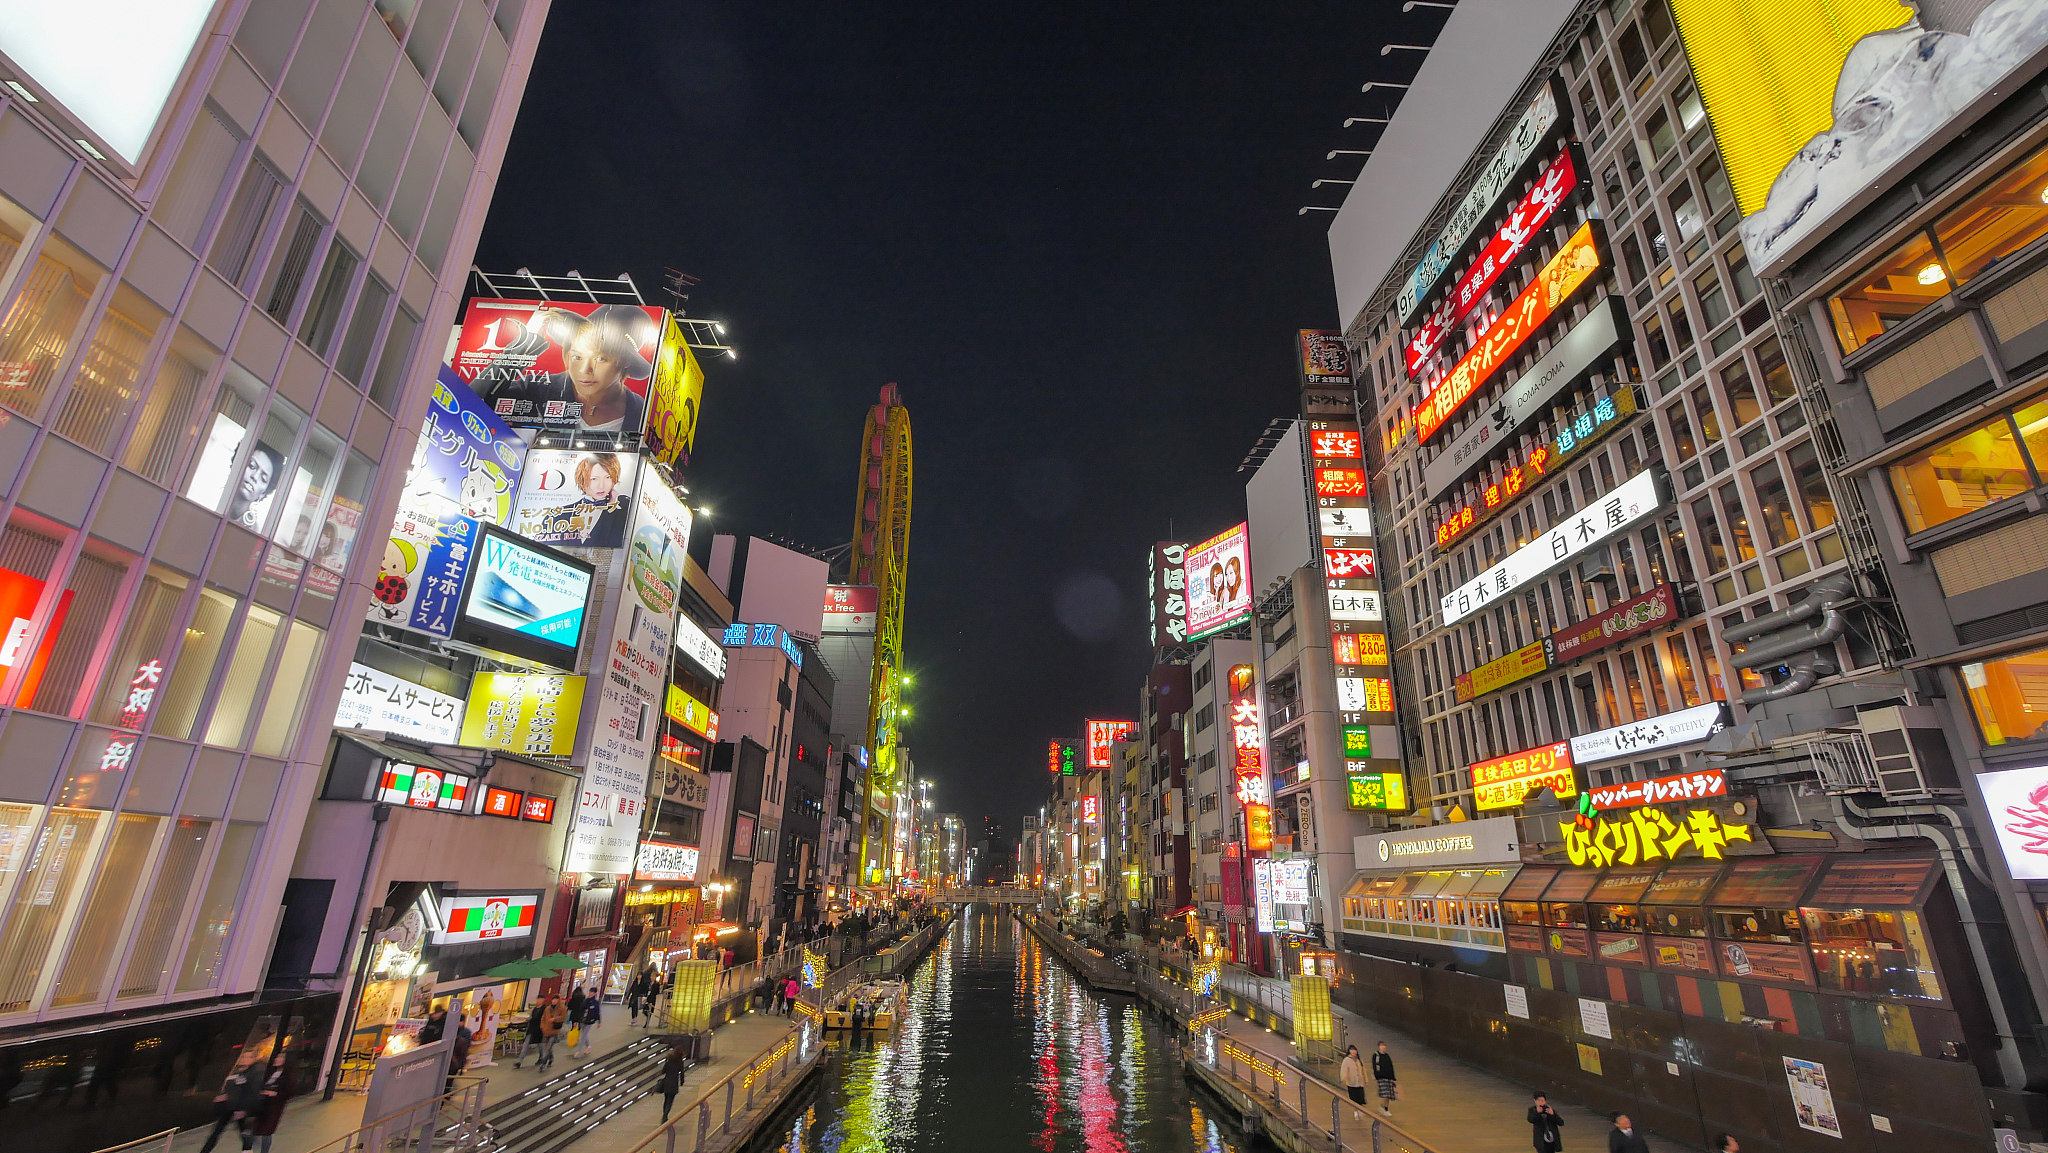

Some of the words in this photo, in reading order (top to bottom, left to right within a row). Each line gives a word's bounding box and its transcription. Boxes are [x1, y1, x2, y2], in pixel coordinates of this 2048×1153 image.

[1399, 288, 1414, 317] 9F
[1434, 288, 1540, 421] 相席ダイニング
[458, 366, 551, 384] NYANNYA
[1308, 374, 1321, 383] 9F
[1516, 360, 1565, 407] DOMA-DOMA
[466, 413, 487, 442] リフォーム
[1311, 422, 1328, 430] 8F
[421, 412, 515, 495] 士グループ
[1315, 459, 1332, 467] 7F
[1323, 469, 1344, 481] 相席
[1317, 481, 1365, 495] ダイニング
[520, 501, 620, 519] モンスターグループ
[1320, 497, 1337, 507] 6F
[1551, 497, 1628, 561] 白木屋
[1333, 538, 1346, 547] 5F
[486, 537, 517, 572] W
[507, 562, 532, 582] 発電
[1325, 551, 1374, 576] はや
[429, 542, 468, 633] 富士ホーム
[1328, 578, 1346, 589] 4F
[1444, 595, 1455, 610] 4F
[1458, 567, 1511, 615] 白木屋
[416, 575, 439, 625] サービス
[823, 604, 833, 612] ax
[835, 603, 855, 612] Free
[1332, 595, 1377, 612] 白木屋
[1601, 596, 1667, 638] いしんでん
[1333, 622, 1350, 632] 3F
[1544, 638, 1555, 665] 3F
[1338, 667, 1355, 677] 2F
[1343, 712, 1361, 723] 1F
[1711, 722, 1725, 734] 2F
[1230, 697, 1265, 805] 大阪王将
[1553, 743, 1567, 758] 2F
[1347, 761, 1367, 772] B1F
[1473, 750, 1556, 785] 豊後高田どり
[664, 766, 697, 802] うなぎ
[1591, 774, 1723, 806] ハンバーグレストラン
[493, 793, 507, 812] 酒
[523, 800, 547, 817] たばこ
[582, 791, 610, 811] コスパ
[1391, 838, 1436, 856] HONOLULU
[1436, 835, 1474, 852] COFFEE
[1559, 806, 1752, 868] びっくりドンキー
